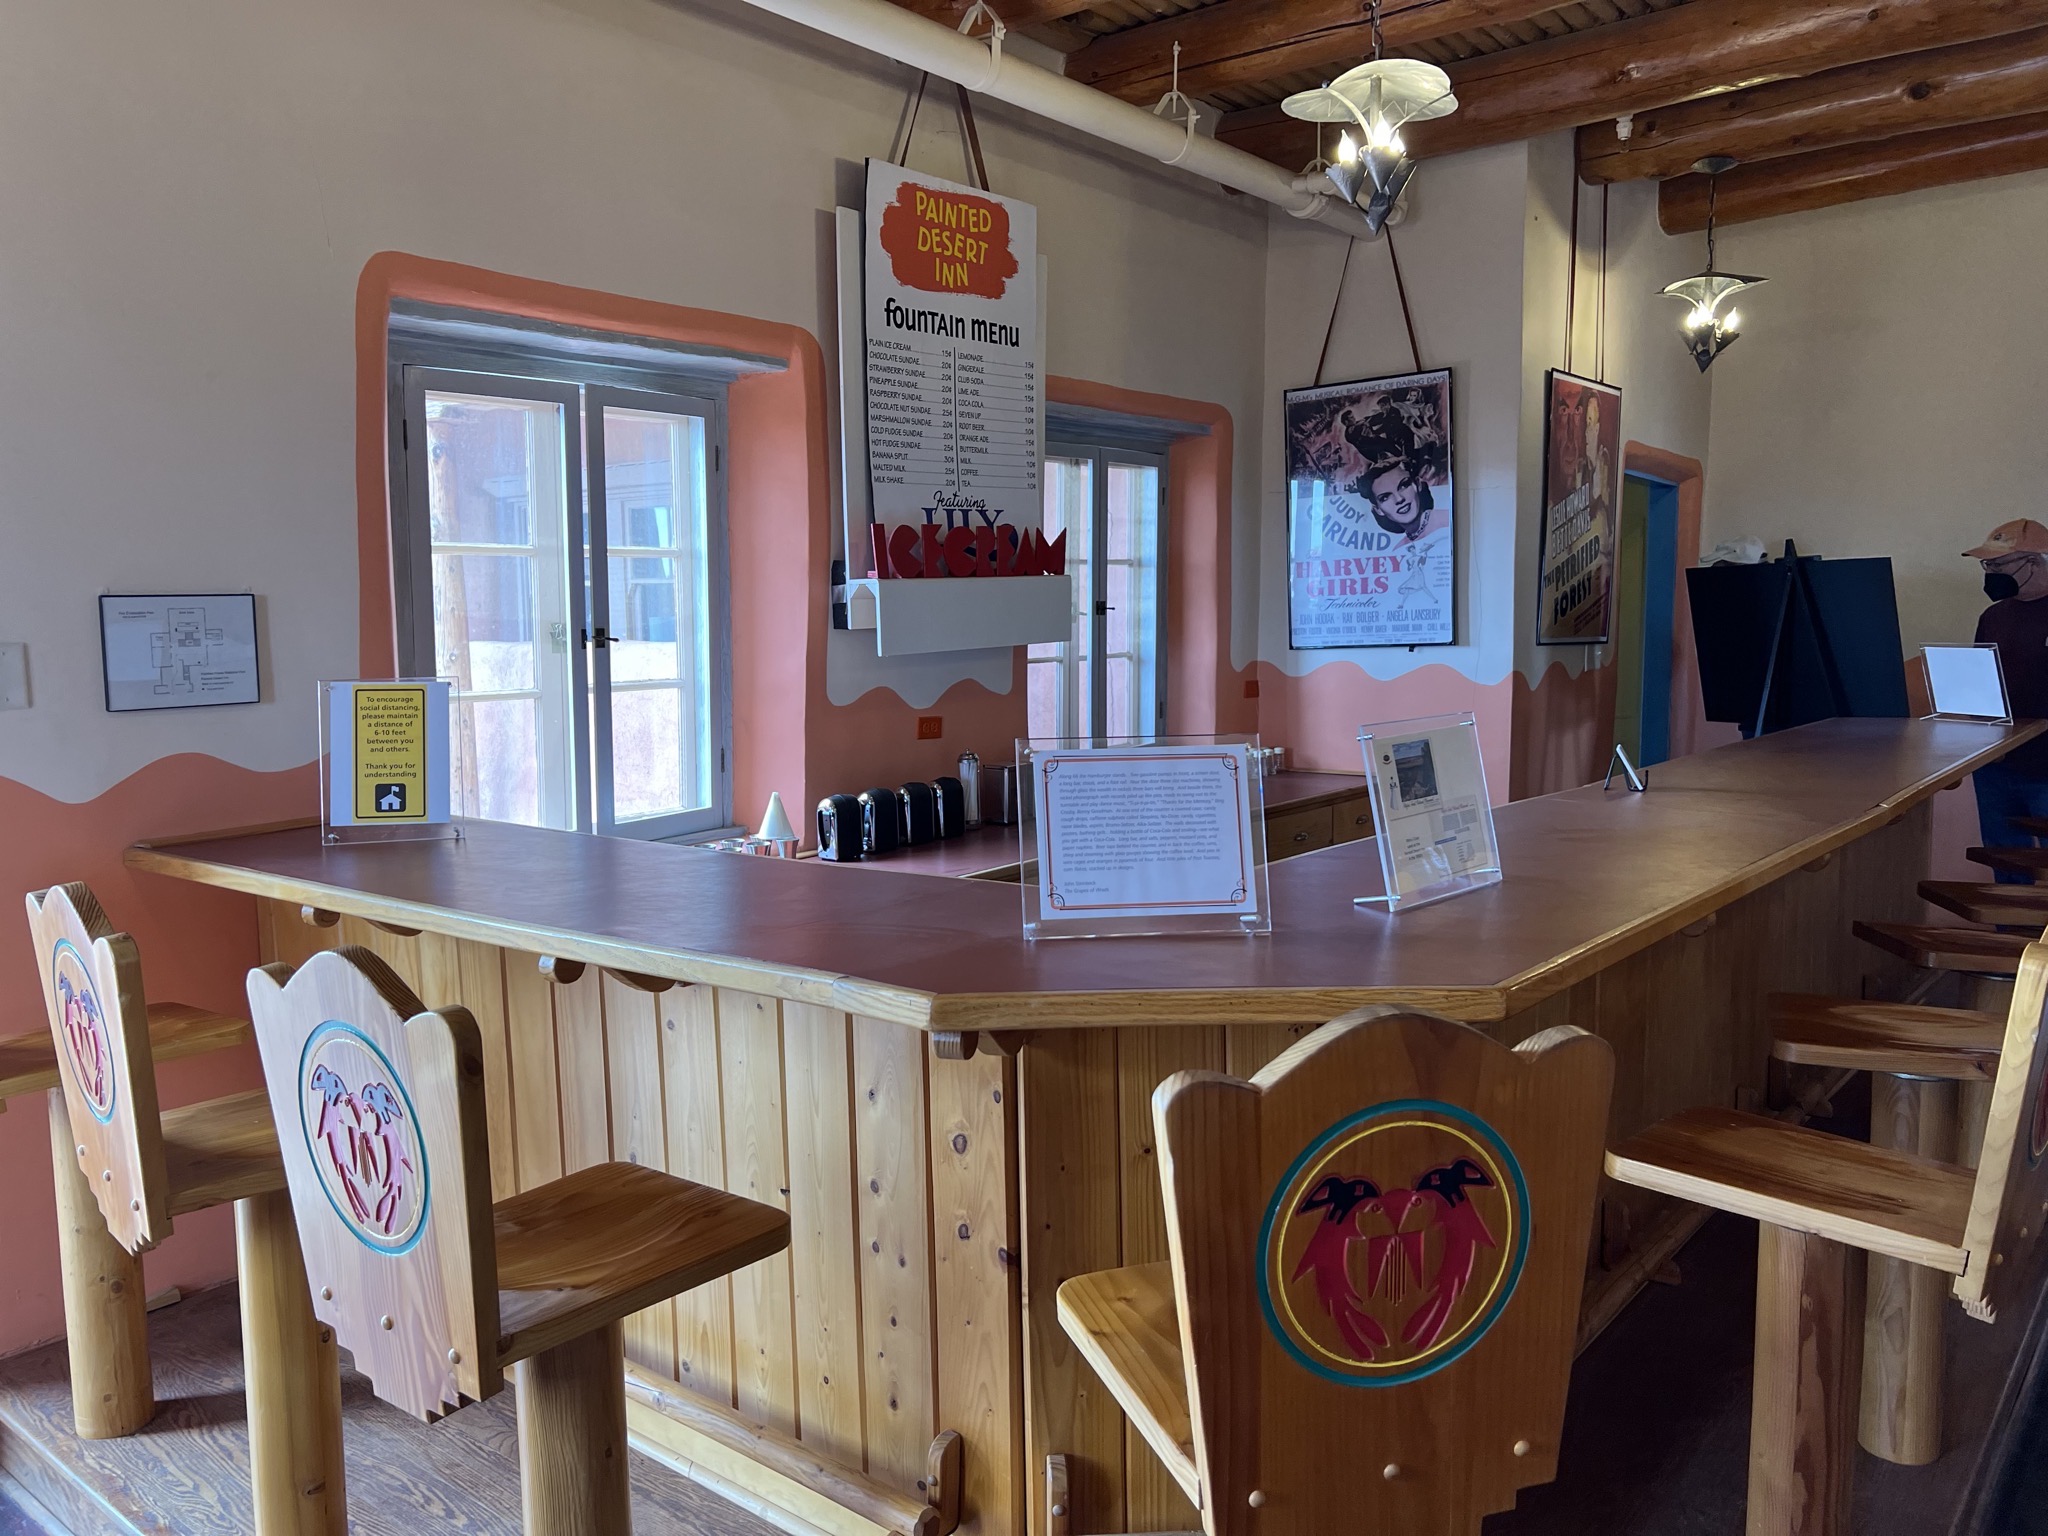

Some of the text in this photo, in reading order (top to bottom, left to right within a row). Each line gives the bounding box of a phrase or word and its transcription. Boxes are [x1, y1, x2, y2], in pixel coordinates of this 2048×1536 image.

[916, 191, 992, 233] PAINTED
[917, 226, 988, 265] DESERT
[935, 257, 969, 288] INN
[869, 339, 883, 347] PLAIN
[893, 342, 911, 351] CREAM
[870, 351, 898, 362] CHOCOLATE
[899, 356, 920, 365] SUNDAE
[958, 352, 983, 362] LEMONADE
[869, 364, 904, 374] STRAWBERRY
[905, 369, 925, 378] SUNDAE
[870, 377, 896, 386] PINEAPPLE
[897, 380, 918, 389] SUNDAE
[1315, 391, 1344, 400] MUSICAL
[1347, 384, 1381, 395] ROMANCE
[1396, 378, 1425, 388] DARING
[870, 389, 900, 398] RASPBERRY
[902, 393, 922, 401] SUNDAE
[870, 401, 898, 411] CHOCOLATE
[911, 406, 931, 414] SUNDAE
[871, 414, 910, 424] MARSHMALLOW
[911, 418, 932, 426] SUNDAE
[903, 429, 923, 437] SUNDAE
[959, 434, 978, 442] ORANGE
[901, 441, 921, 449] SUNDAE
[960, 446, 989, 454] BUTTERMILK
[872, 451, 893, 459] BANANA
[934, 490, 986, 514] Featuring
[1329, 496, 1364, 524] JUDY
[871, 523, 1067, 578] ICE CREAM
[1296, 555, 1406, 578] HARVEY
[1555, 535, 1600, 592] PETRIFIED
[1307, 576, 1389, 598] GIRLS
[1323, 597, 1381, 611] Technicolor
[1554, 570, 1592, 625] FOREST
[1300, 614, 1313, 625] JOHN
[1342, 612, 1354, 623] RAY
[1357, 611, 1379, 623] BOLGER
[1387, 609, 1408, 622] ANGELA
[1411, 609, 1441, 620] LANSBURY
